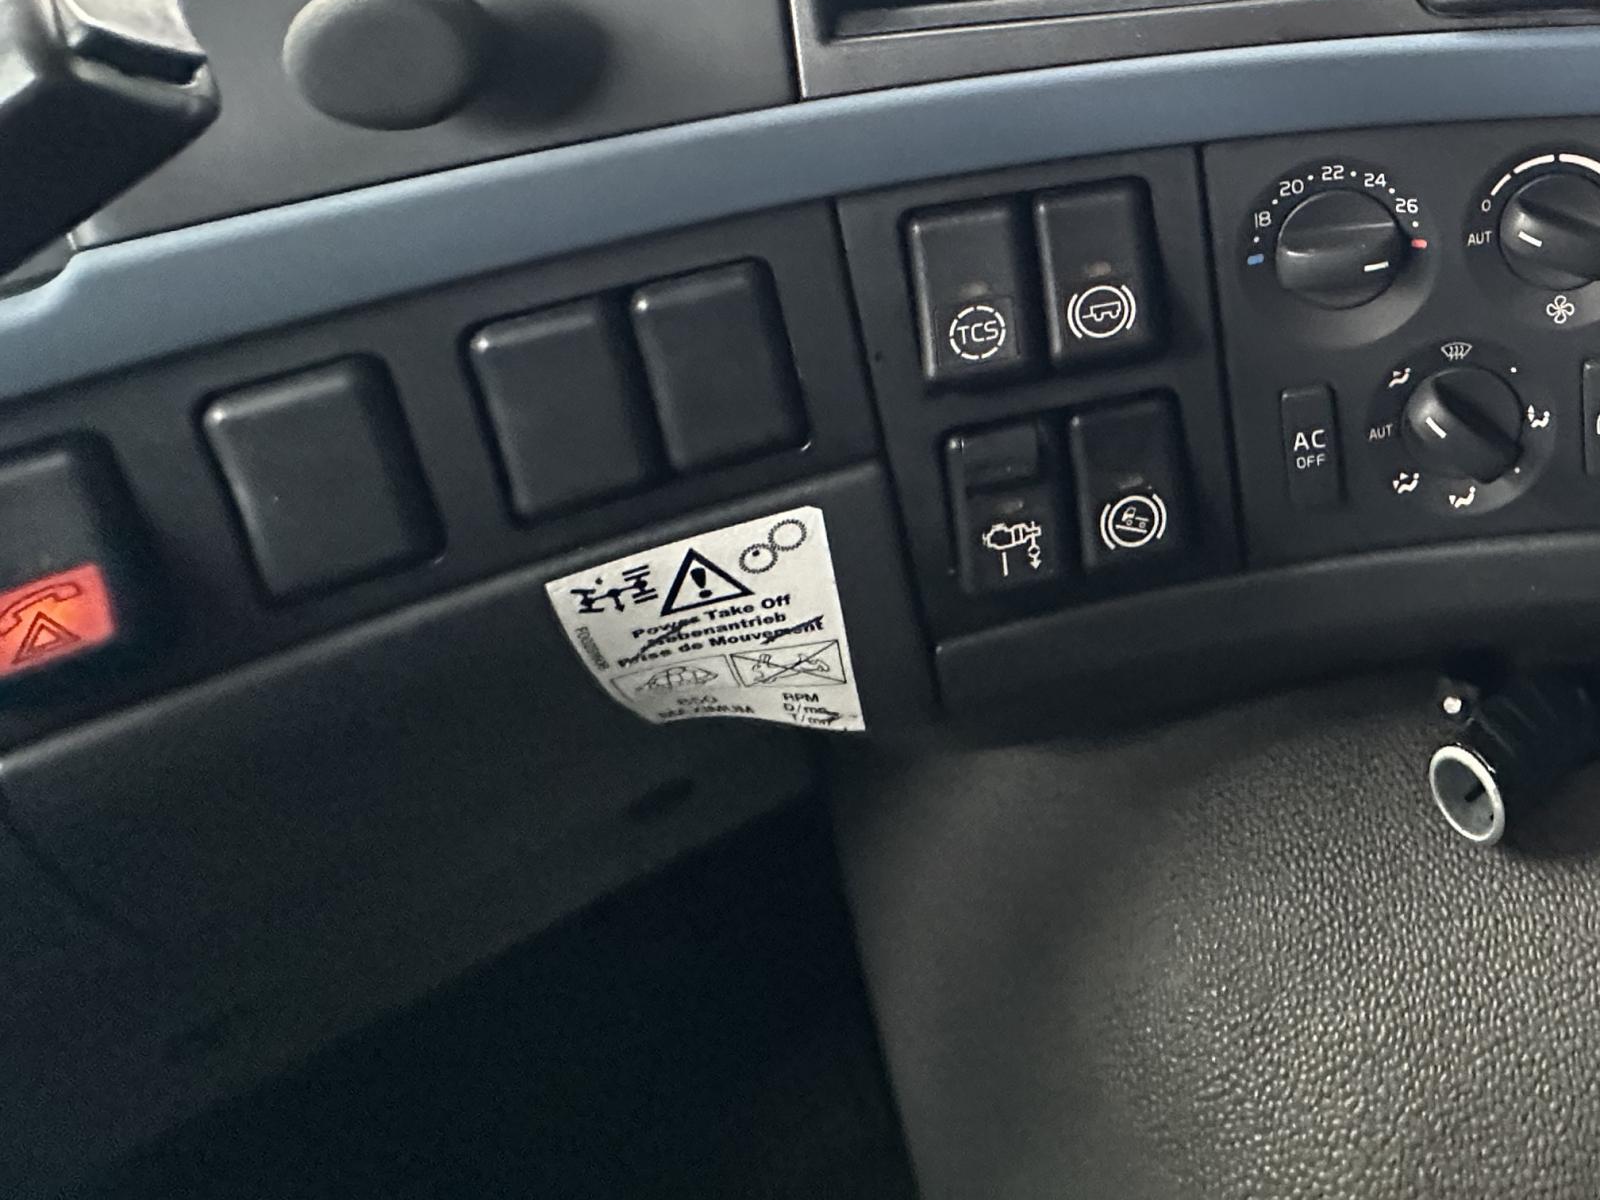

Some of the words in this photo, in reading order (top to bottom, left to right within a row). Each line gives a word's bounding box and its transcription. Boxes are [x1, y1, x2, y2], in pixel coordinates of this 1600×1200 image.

[1321, 165, 1345, 181] 22
[1364, 173, 1387, 188] 24
[1279, 180, 1305, 197] 20
[1395, 198, 1418, 214] 26
[1254, 211, 1271, 228] 18
[1467, 231, 1492, 246] AUT
[957, 319, 998, 345] TCS
[1294, 430, 1325, 450] AC
[1369, 425, 1393, 441] AUT
[1296, 454, 1326, 469] OFF
[703, 603, 754, 621] Take
[761, 594, 791, 609] Off
[646, 612, 787, 647] ebenantrieb
[678, 641, 704, 653] de
[782, 692, 819, 703] RPM
